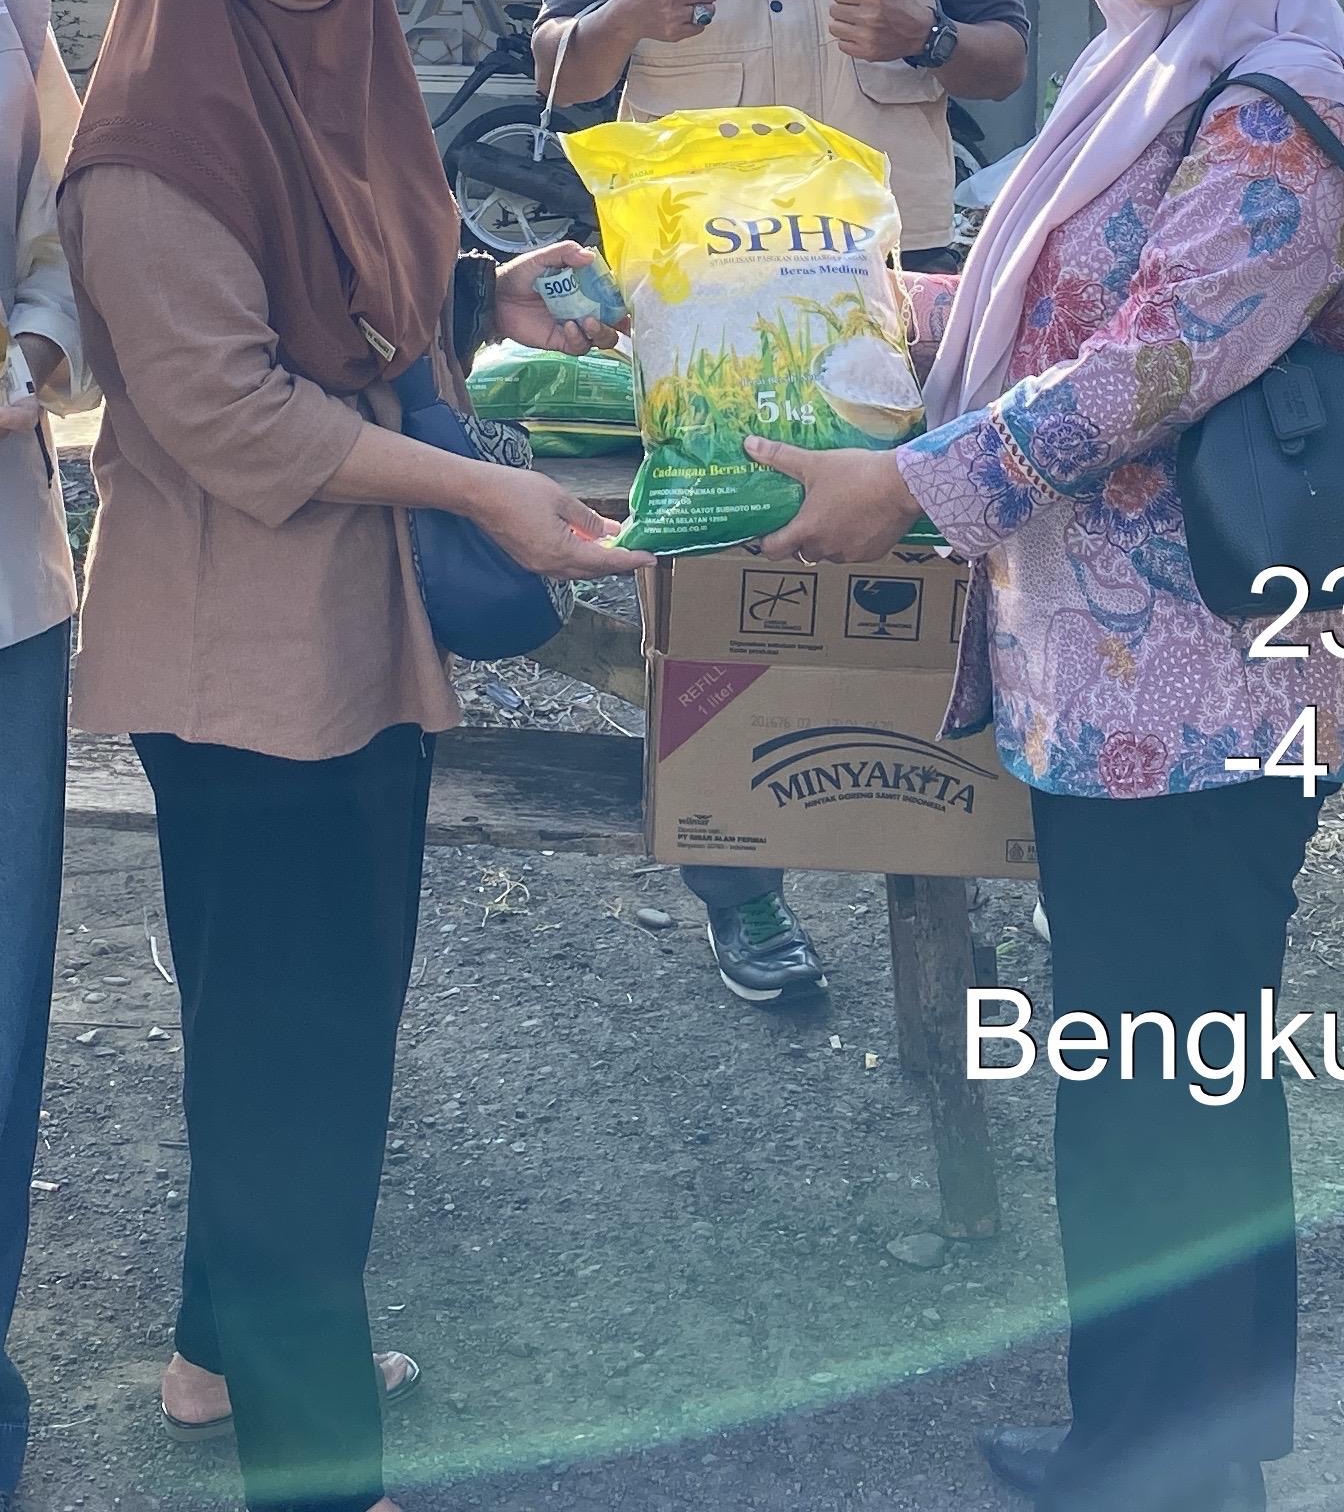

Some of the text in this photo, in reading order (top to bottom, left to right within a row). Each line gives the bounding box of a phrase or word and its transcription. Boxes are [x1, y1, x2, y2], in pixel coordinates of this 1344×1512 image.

[705, 214, 877, 256] SPHP
[780, 265, 870, 277] Beras Medium
[757, 391, 816, 424] 5 kg
[652, 464, 707, 479] Cadangan
[710, 463, 747, 476] Beras
[677, 664, 728, 707] REFILL
[705, 681, 737, 709] liter
[767, 760, 976, 814] MINYAKITA
